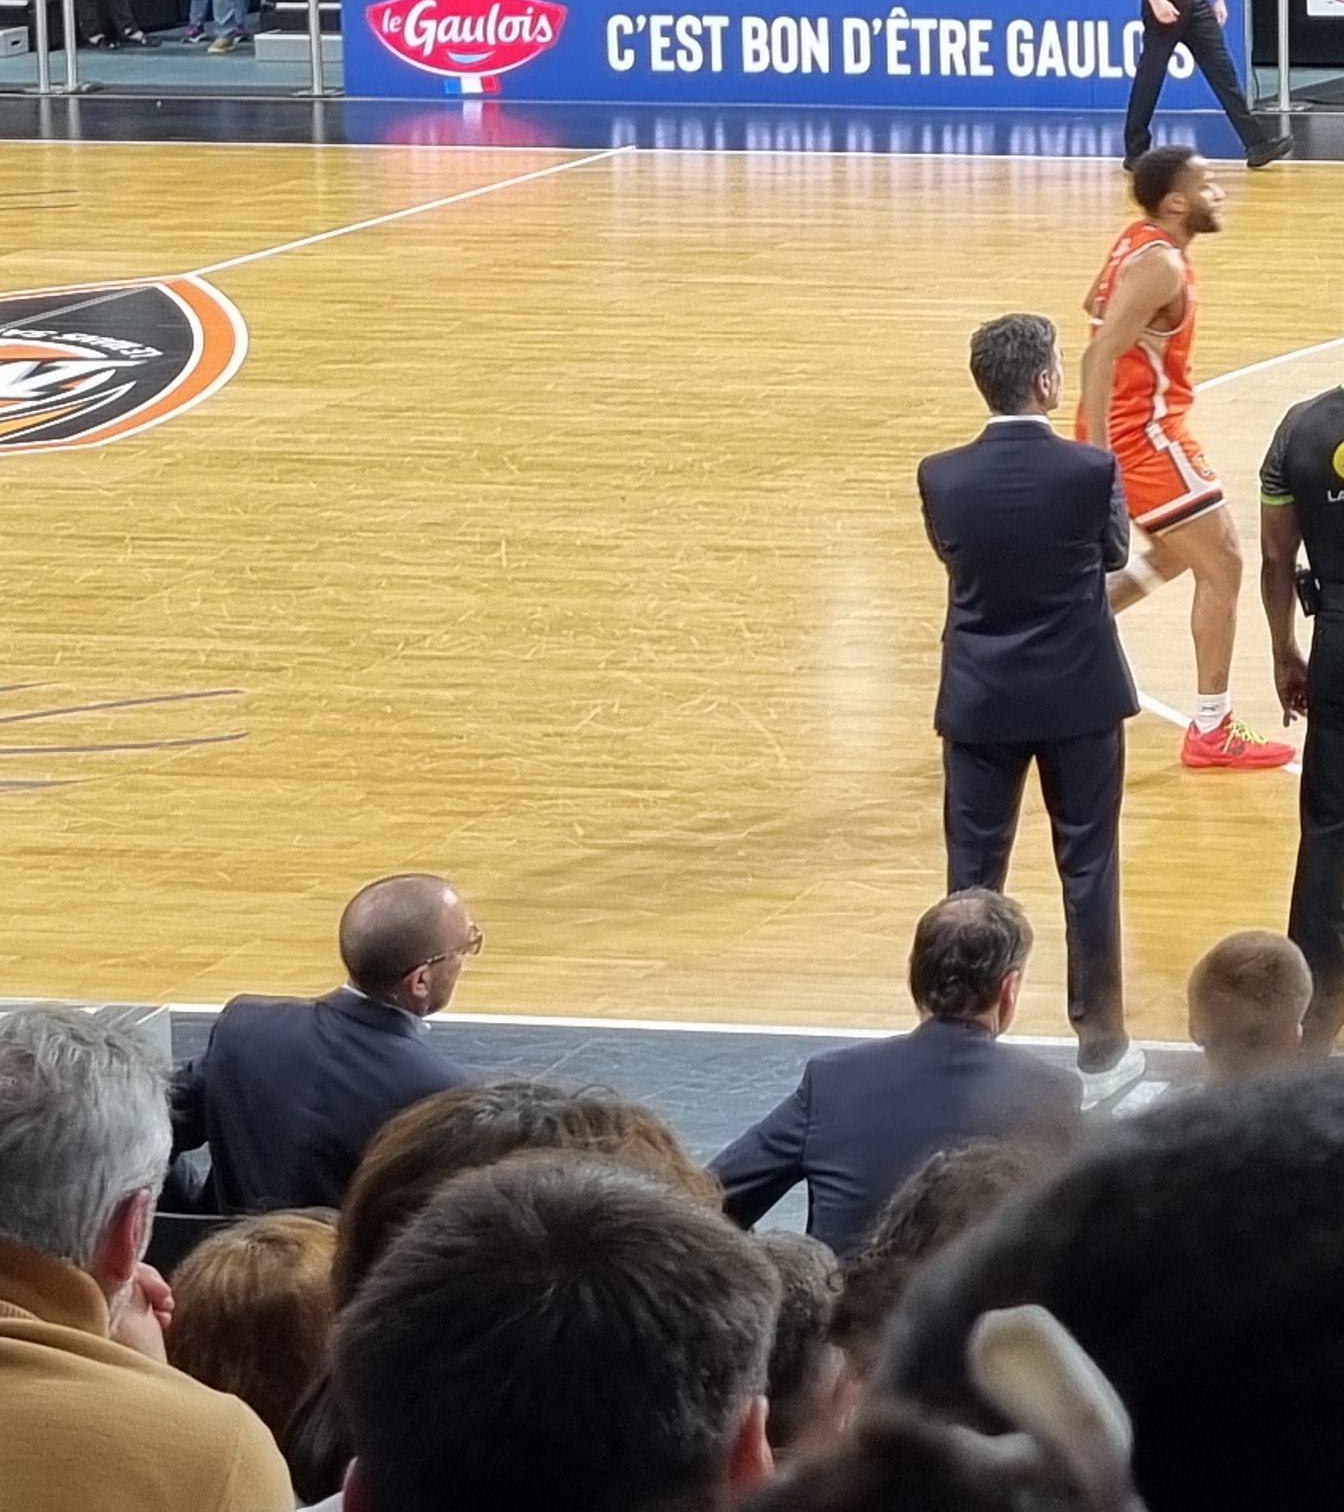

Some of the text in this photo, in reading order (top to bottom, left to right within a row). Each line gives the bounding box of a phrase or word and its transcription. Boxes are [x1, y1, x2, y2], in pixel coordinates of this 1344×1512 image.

[381, 11, 402, 36] le
[742, 16, 830, 75] BON
[1006, 18, 1196, 80] GAULOS
